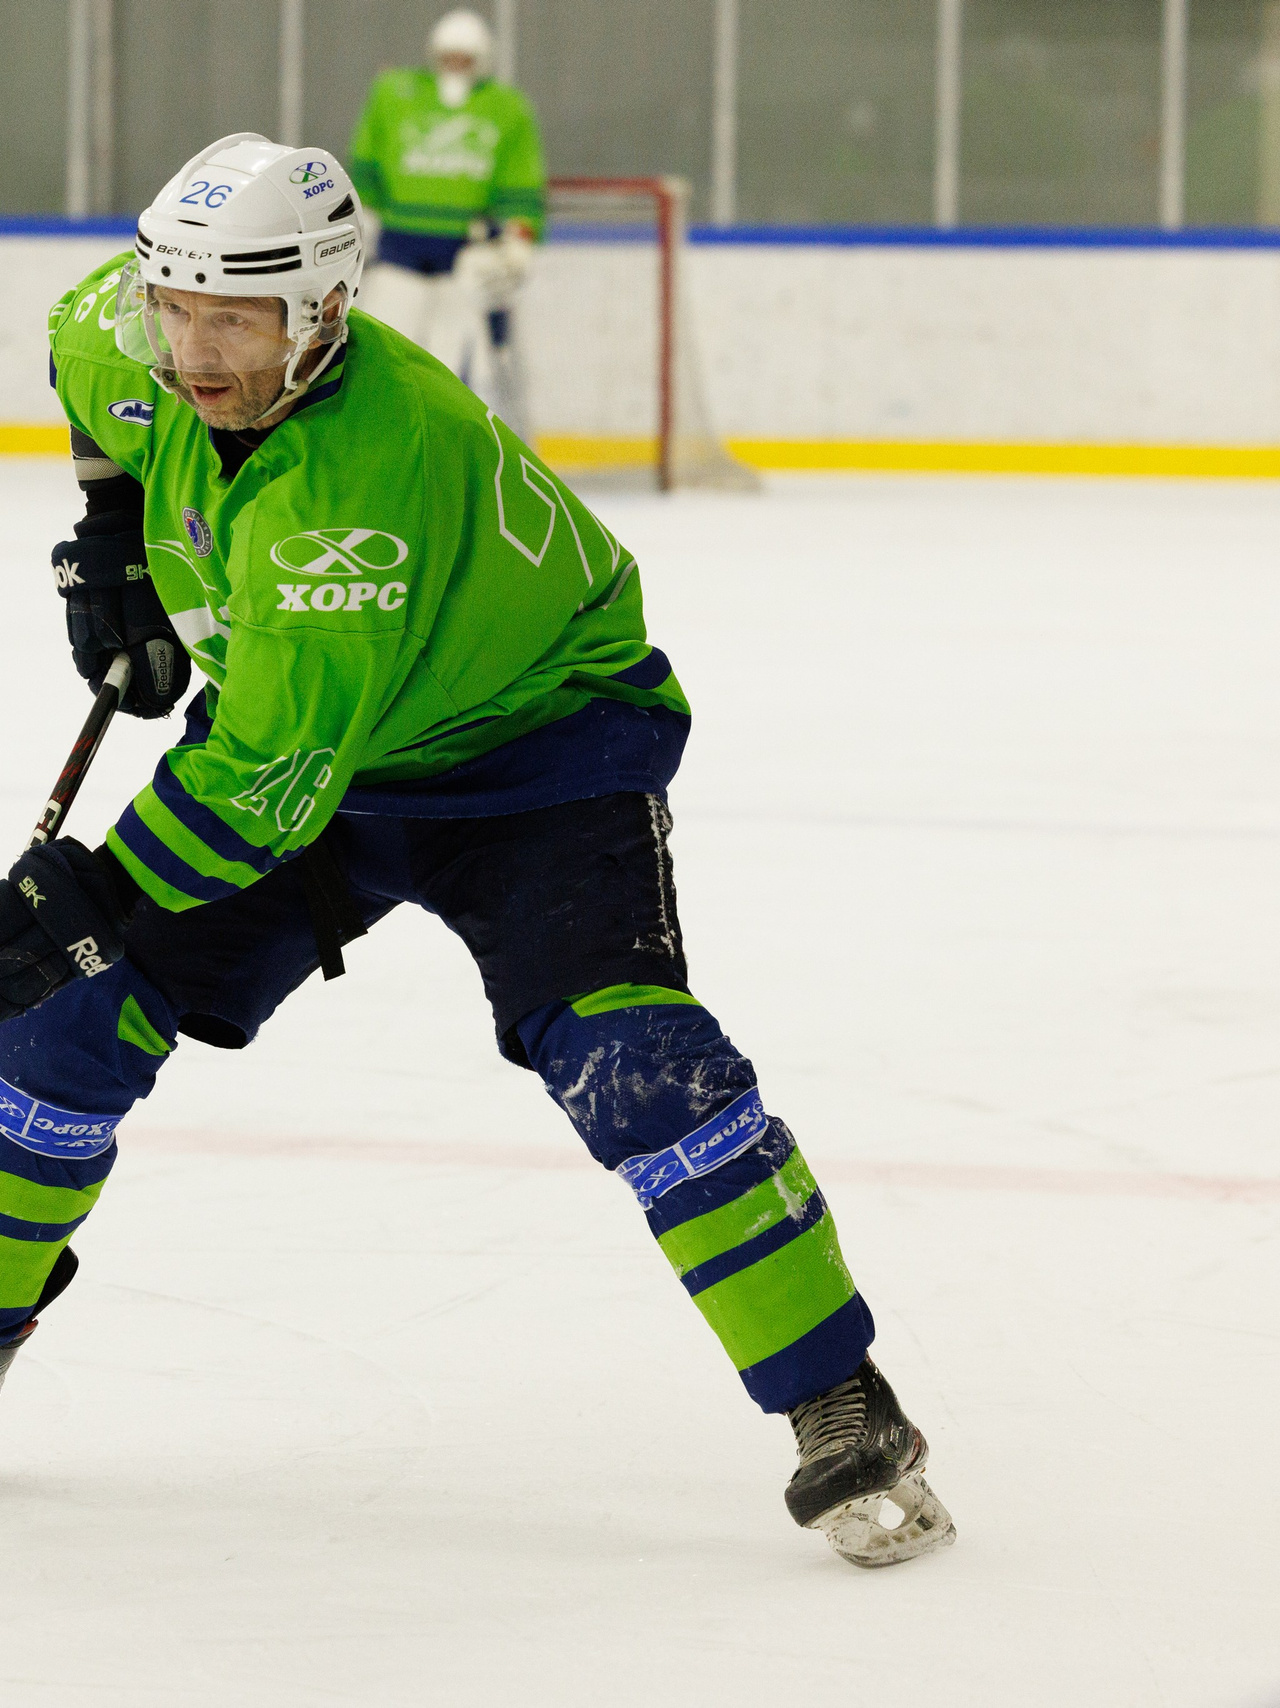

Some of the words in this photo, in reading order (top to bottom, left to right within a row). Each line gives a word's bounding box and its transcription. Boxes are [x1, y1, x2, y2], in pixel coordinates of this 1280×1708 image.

[179, 180, 233, 208] 26
[303, 179, 335, 200] ХОРС
[319, 238, 356, 258] BAUER
[276, 581, 408, 612] ХОРС
[157, 647, 169, 688] Reebok
[18, 875, 47, 909] 9K
[33, 1117, 108, 1136] ХОРС
